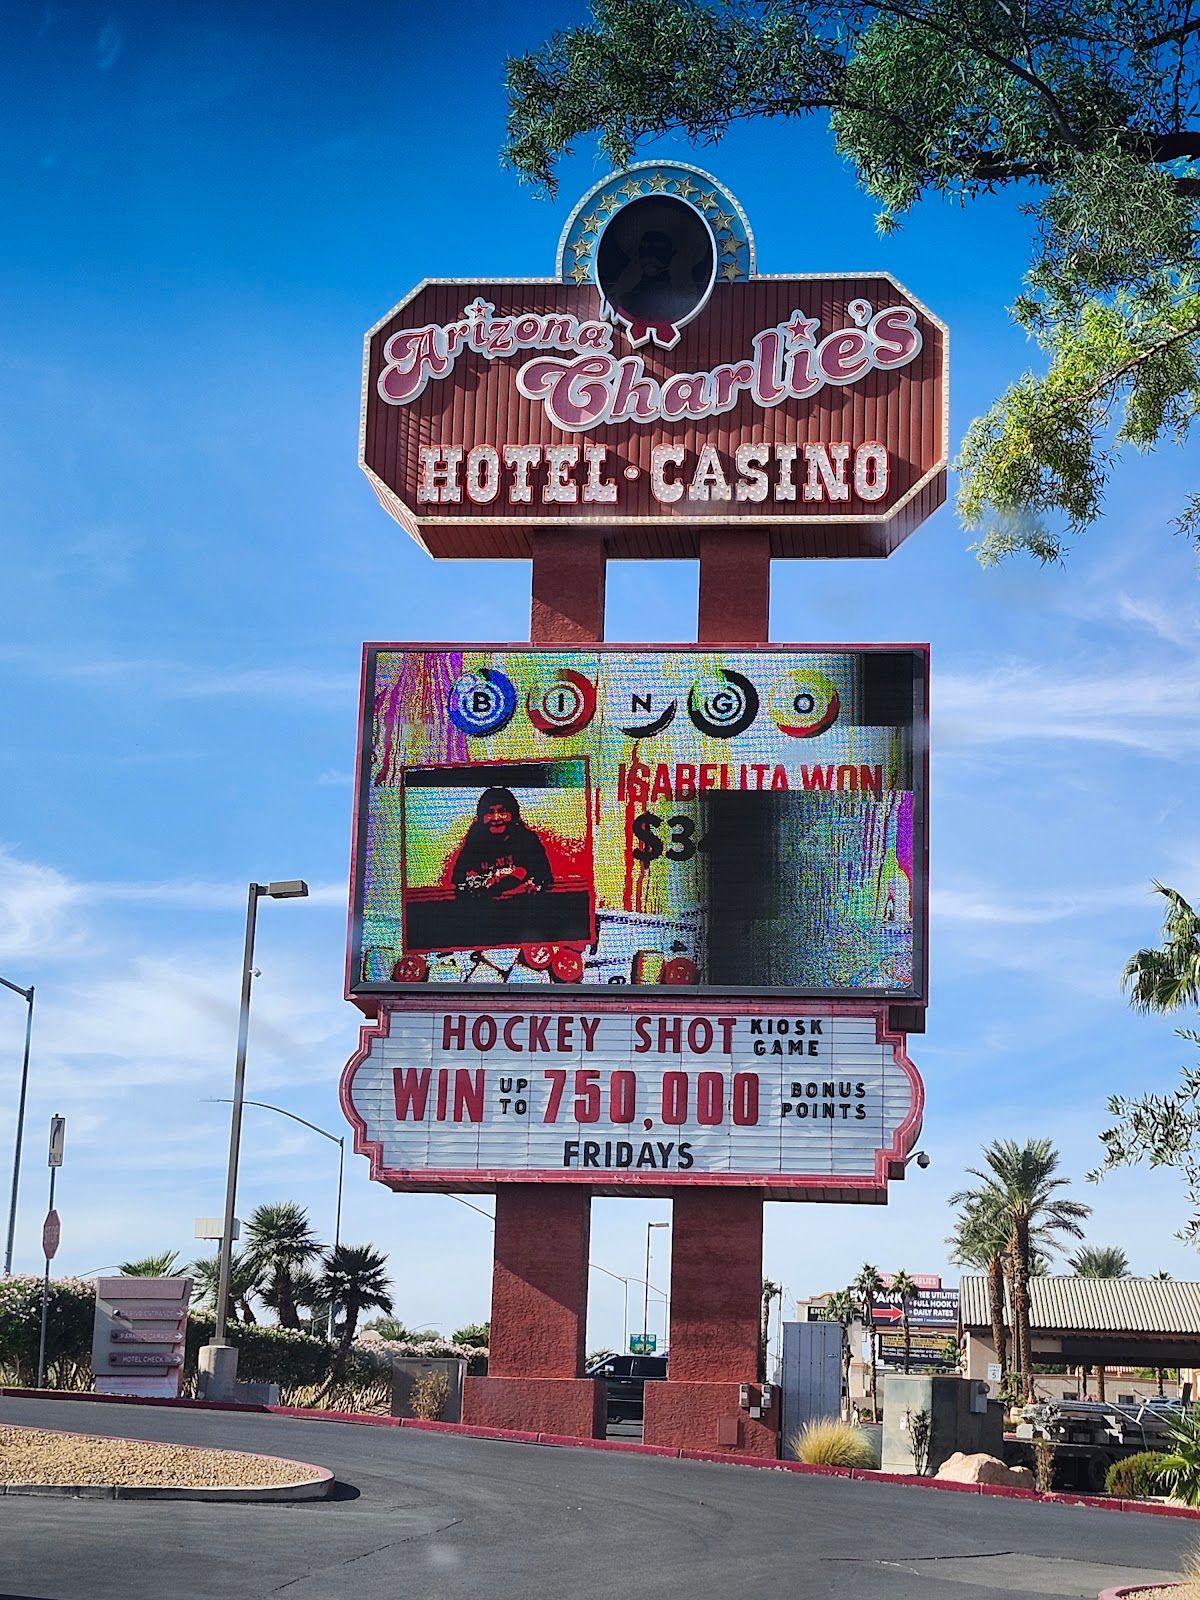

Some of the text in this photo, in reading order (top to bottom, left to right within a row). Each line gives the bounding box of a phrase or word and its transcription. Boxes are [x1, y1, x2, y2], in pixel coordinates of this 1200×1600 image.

[378, 297, 612, 405] Arizona
[516, 299, 922, 432] Charlie's
[417, 442, 889, 503] HOTEL CASINO
[800, 763, 883, 791] WON
[442, 1015, 737, 1054] HOCKEY SHOT
[750, 1018, 823, 1036] KIOSK
[753, 1040, 820, 1057] GAME
[392, 1068, 486, 1122] WIN
[499, 1078, 528, 1094] UP
[790, 1081, 867, 1098] BONUS
[499, 1099, 527, 1115] TO
[542, 1070, 760, 1132] 750,000
[780, 1102, 867, 1119] POINTS
[563, 1141, 694, 1169] FRIDAYS
[913, 1300, 930, 1308] FULL
[913, 1309, 954, 1317] DAILY RATES
